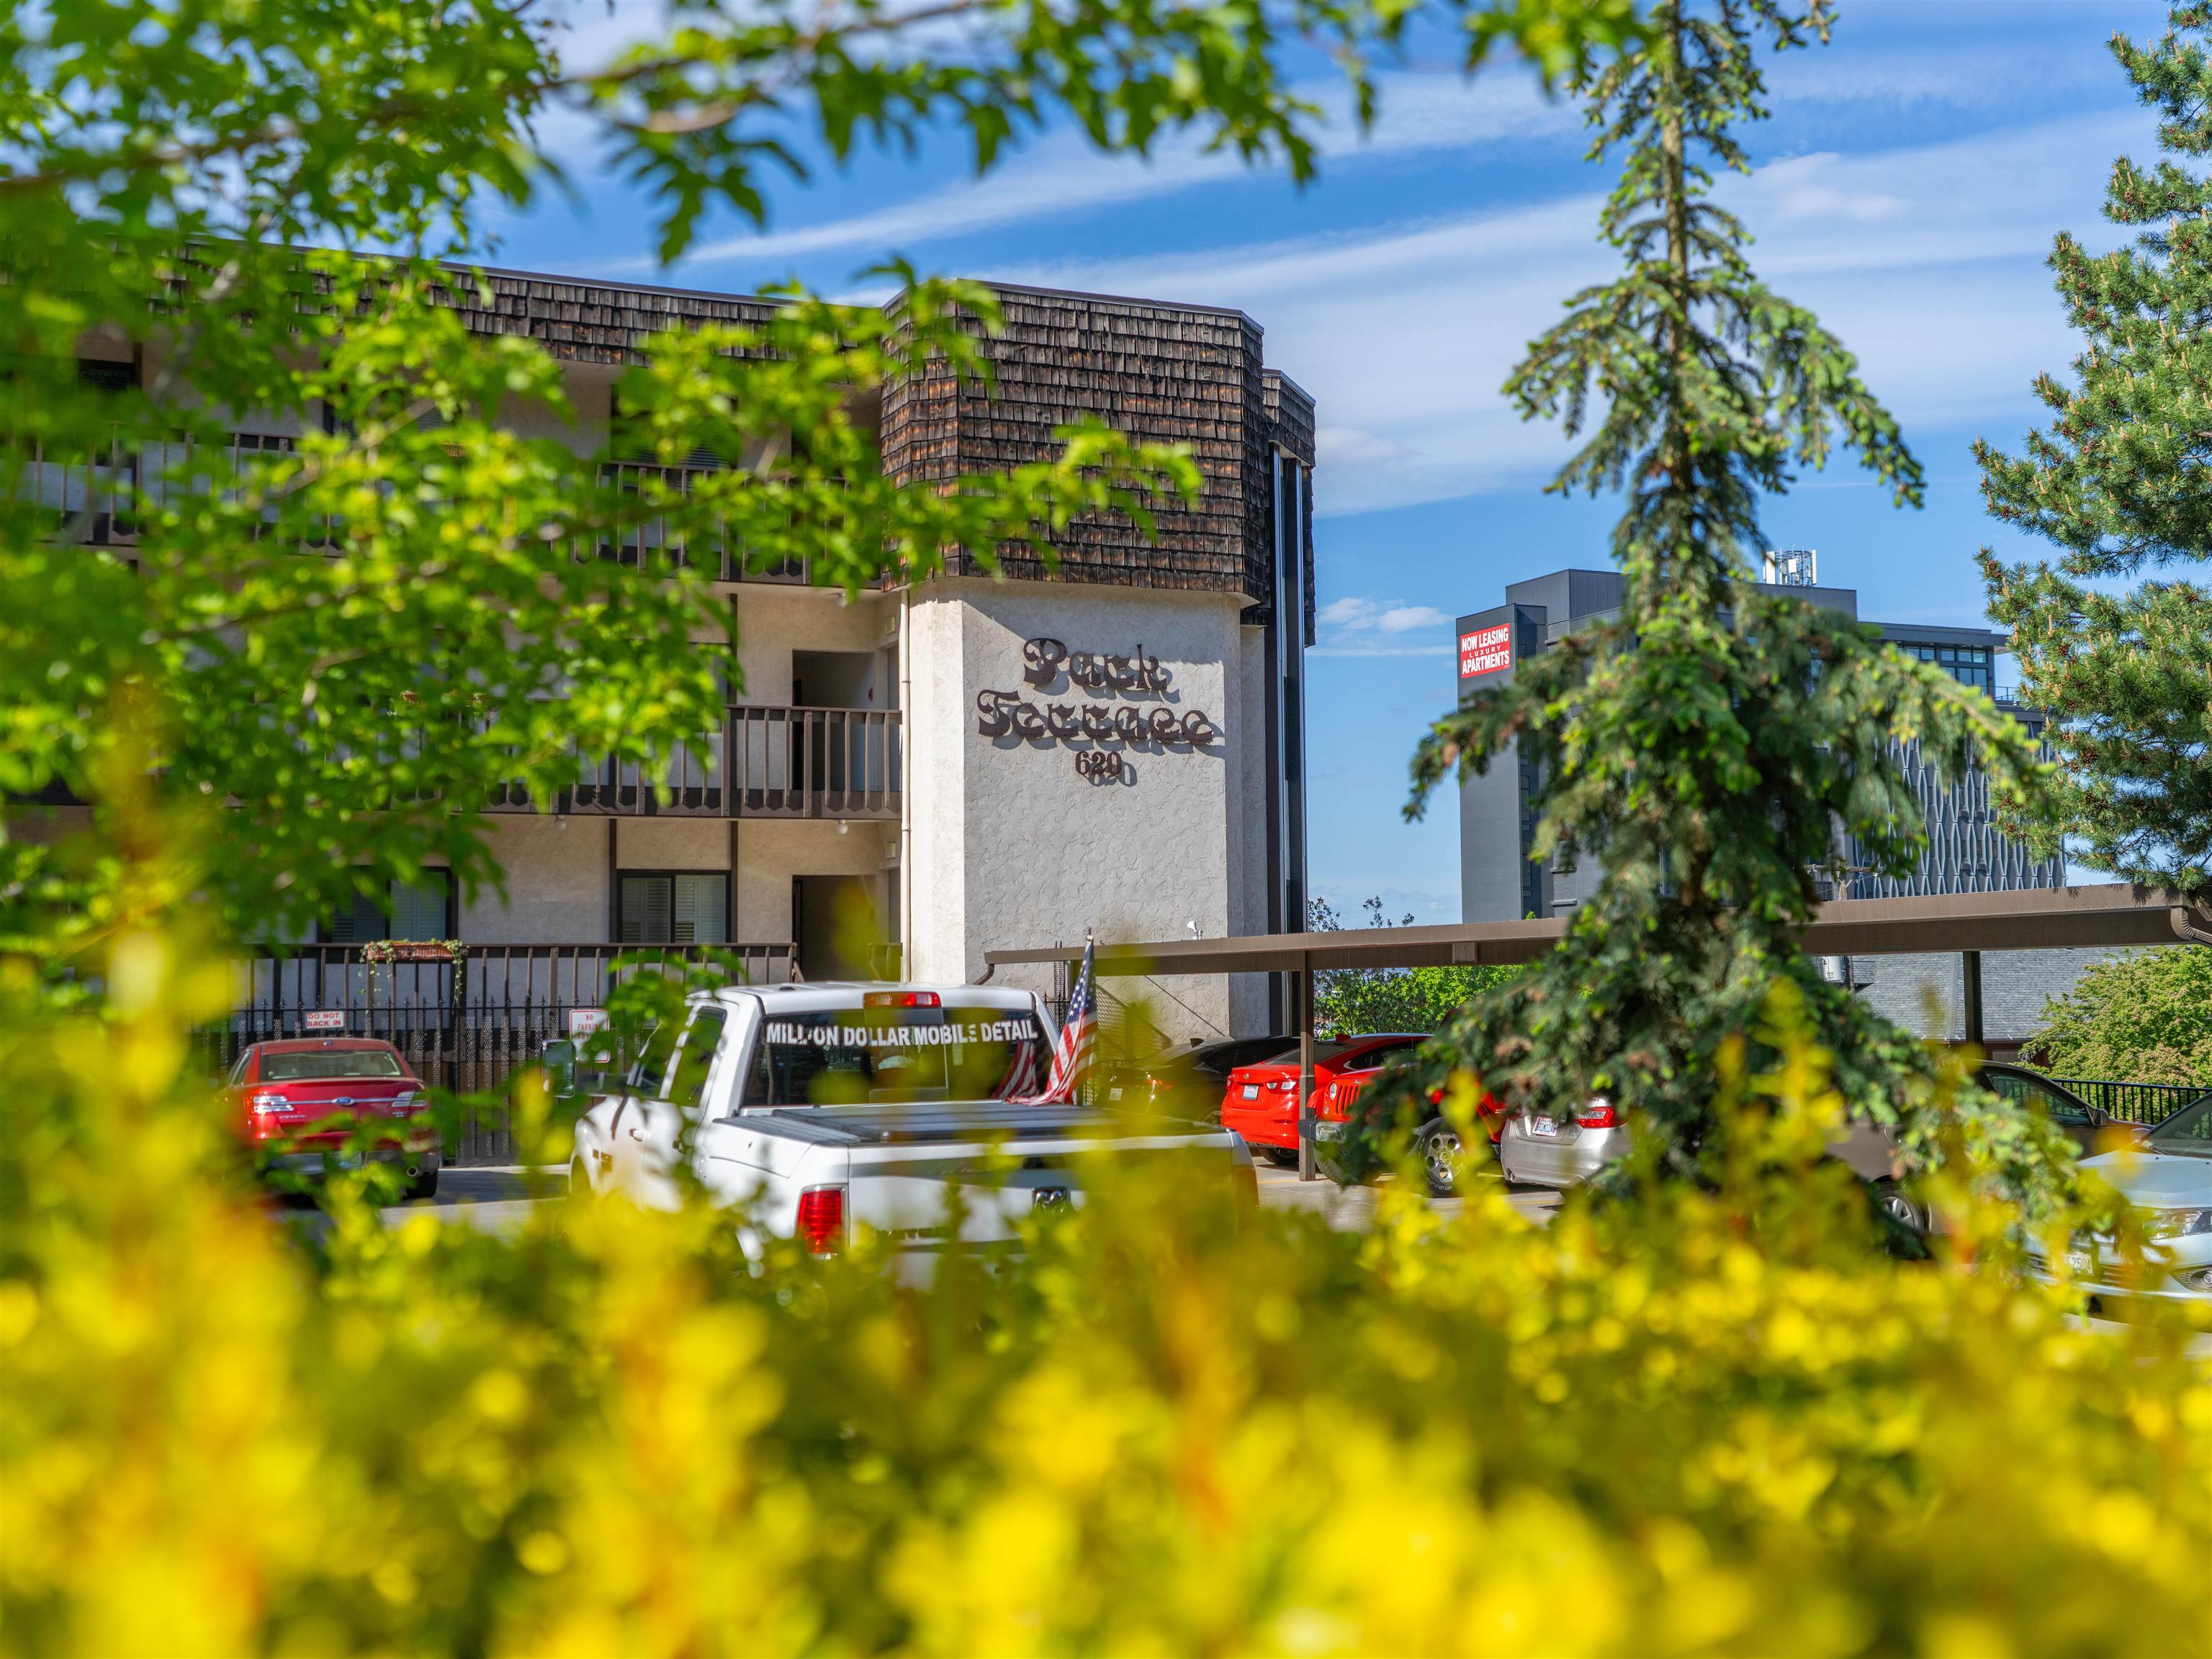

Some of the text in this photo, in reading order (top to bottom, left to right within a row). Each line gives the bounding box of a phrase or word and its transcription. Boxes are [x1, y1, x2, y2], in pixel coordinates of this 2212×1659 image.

[1462, 628, 1508, 652] NOW LEASING
[1470, 645, 1501, 657] LUXURY
[1462, 650, 1509, 674] APARTMENTS
[977, 689, 1213, 744] Terrace
[1075, 750, 1123, 775] 620
[843, 1025, 910, 1046] DOLLAR
[914, 1023, 978, 1046] MOBILE
[981, 1018, 1039, 1043] DETAIL
